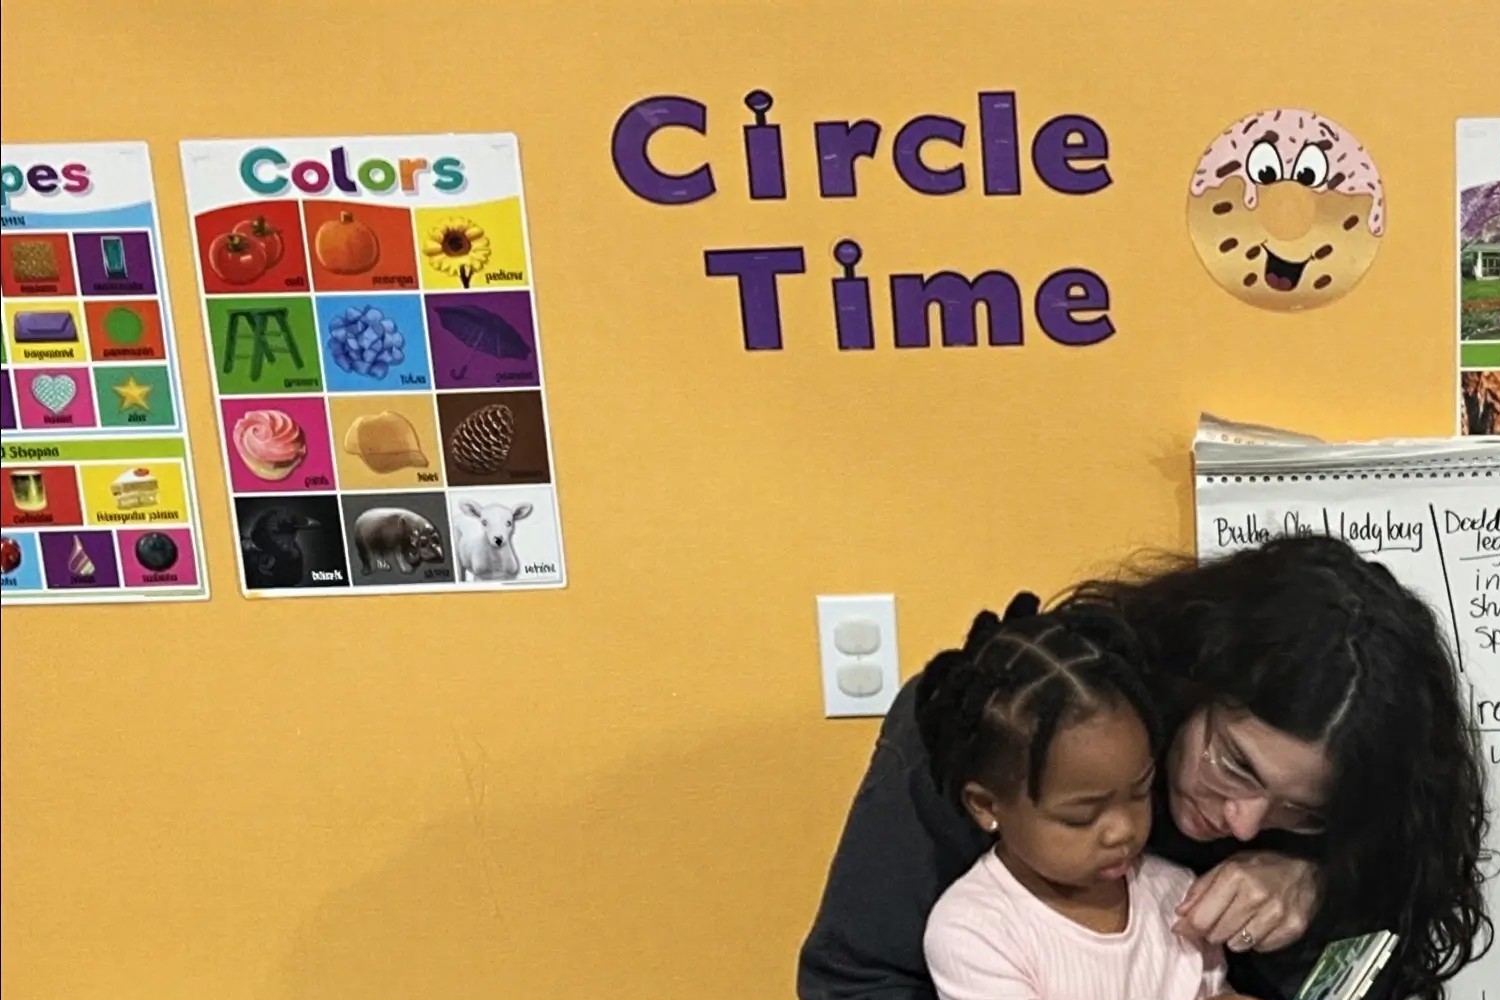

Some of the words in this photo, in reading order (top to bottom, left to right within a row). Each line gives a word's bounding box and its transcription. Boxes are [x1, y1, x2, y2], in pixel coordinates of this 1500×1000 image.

[239, 146, 465, 195] Colors
[611, 90, 1113, 206] Circle
[703, 239, 1116, 351] Time
[1475, 568, 1500, 591] in
